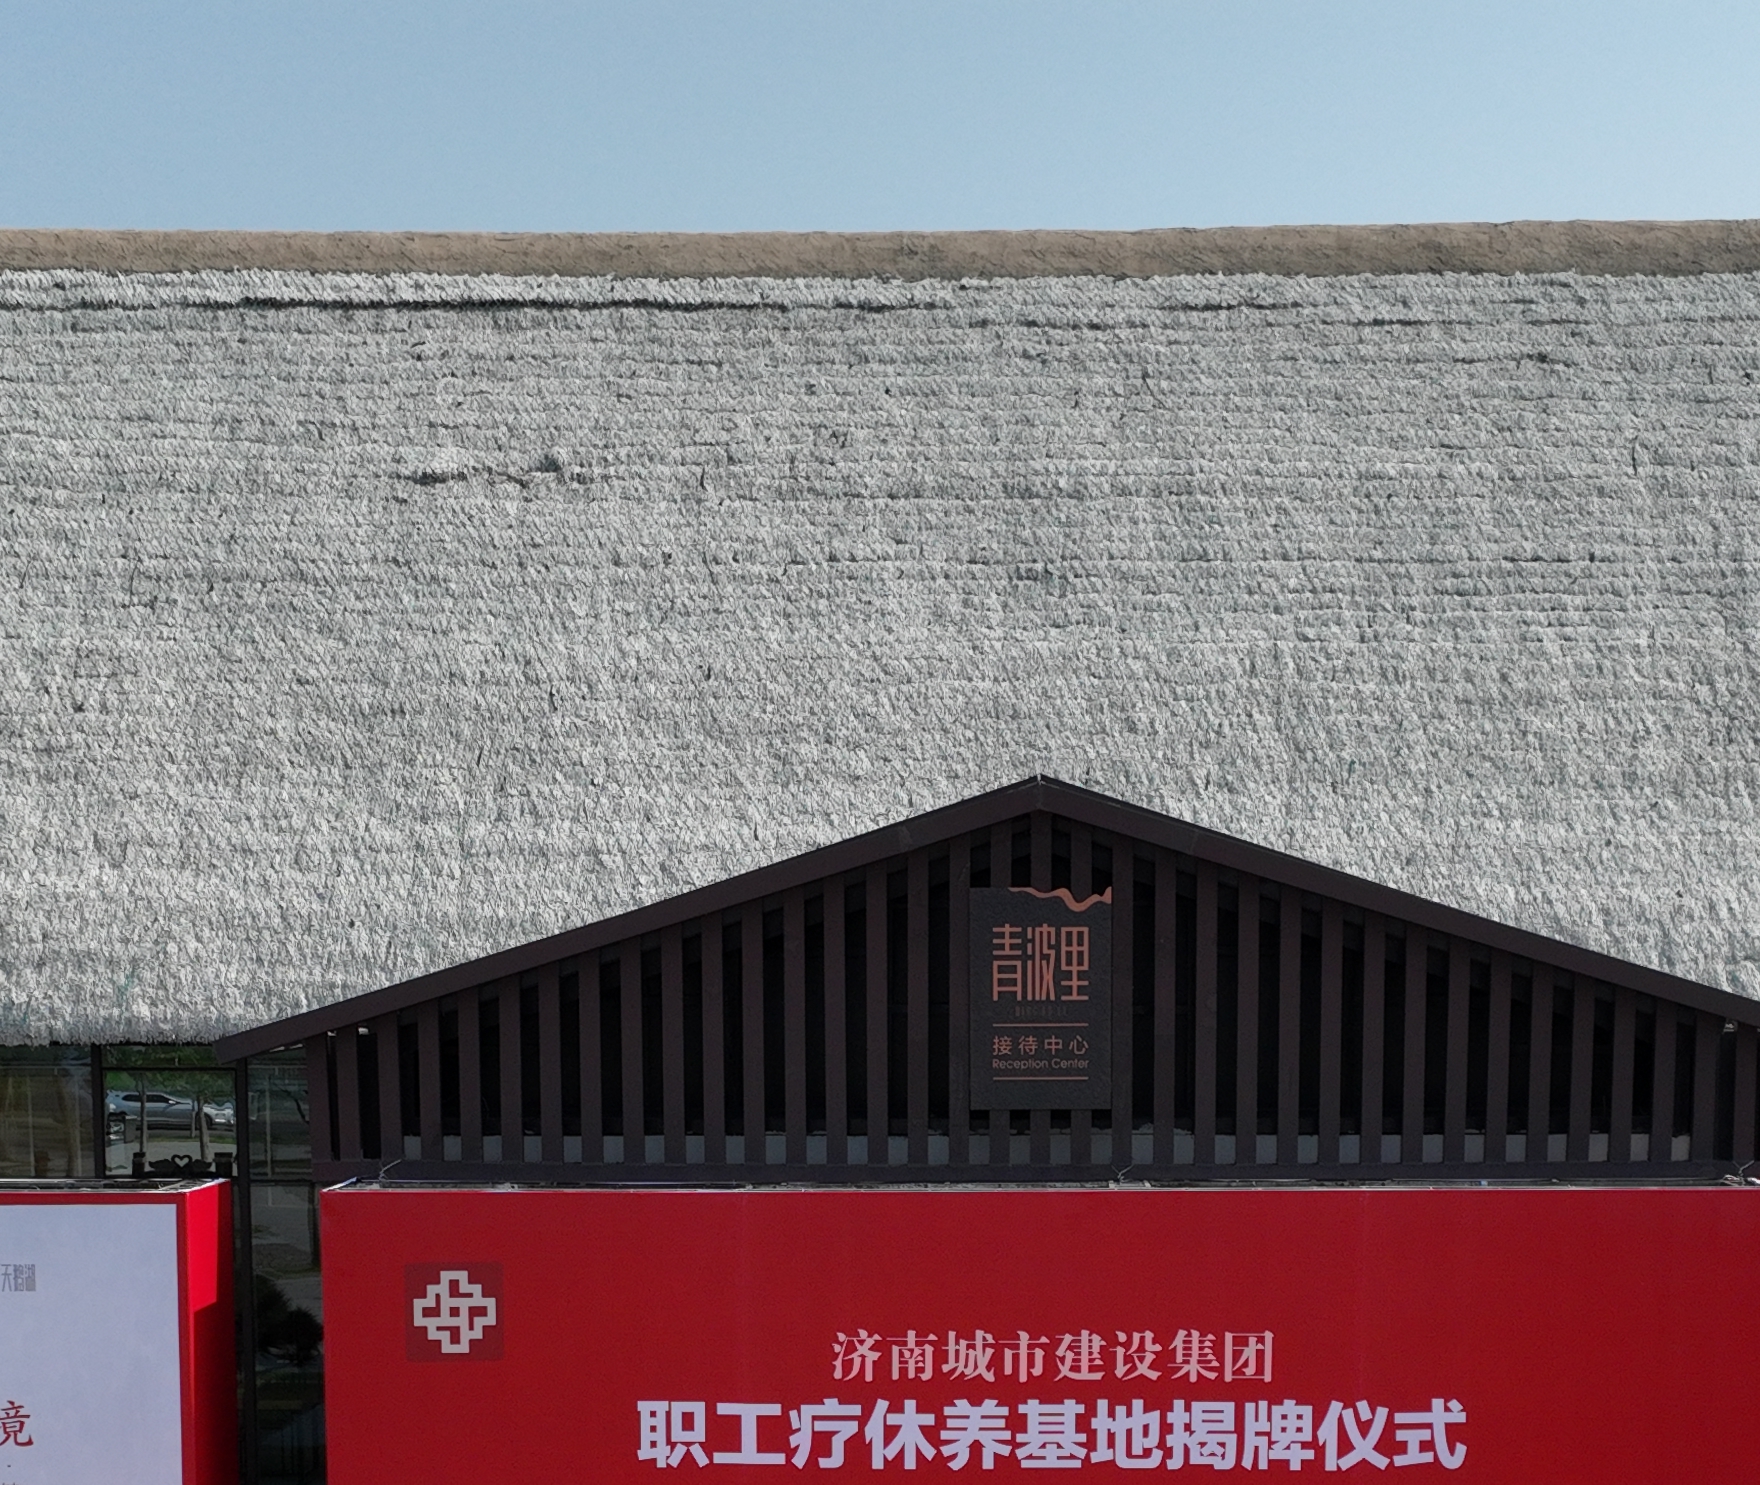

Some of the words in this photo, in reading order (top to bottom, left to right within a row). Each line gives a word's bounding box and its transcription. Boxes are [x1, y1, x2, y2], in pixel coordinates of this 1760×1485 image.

[993, 924, 1089, 1001] 青波里
[992, 1058, 1049, 1070] Reception
[1051, 1058, 1089, 1069] Center
[993, 1035, 1089, 1056] 接待中心
[831, 1329, 1275, 1383] 济南城市建设集团
[637, 1398, 1468, 1472] 职工疗休养基地揭牌仪式
